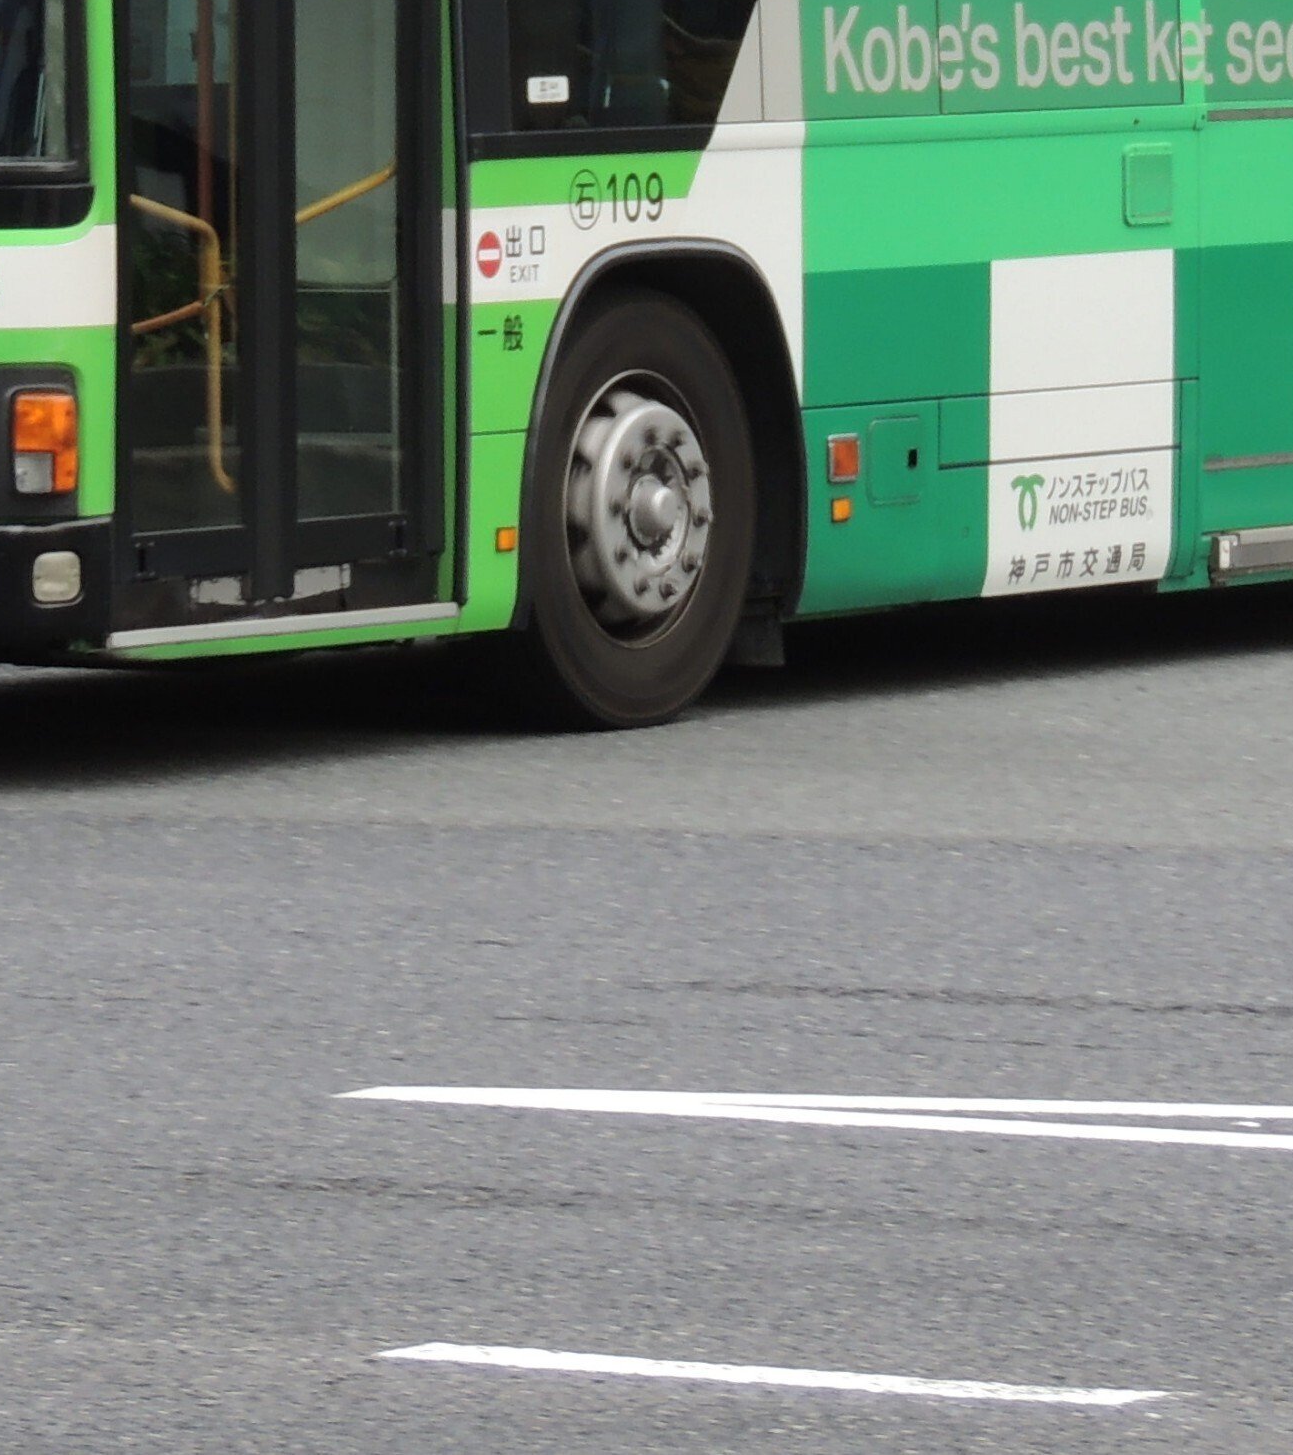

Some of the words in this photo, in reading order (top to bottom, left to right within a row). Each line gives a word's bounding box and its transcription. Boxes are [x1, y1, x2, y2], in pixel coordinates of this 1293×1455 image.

[823, 2, 999, 94] Kobe's
[1013, 1, 1133, 88] best
[505, 225, 546, 258] 出口
[509, 264, 540, 283] EXIT
[1046, 468, 1150, 501] ノンステップバス
[1048, 500, 1116, 526] NON-STEP
[1119, 496, 1148, 519] BUS
[1007, 542, 1147, 586] 神戸市交通局
